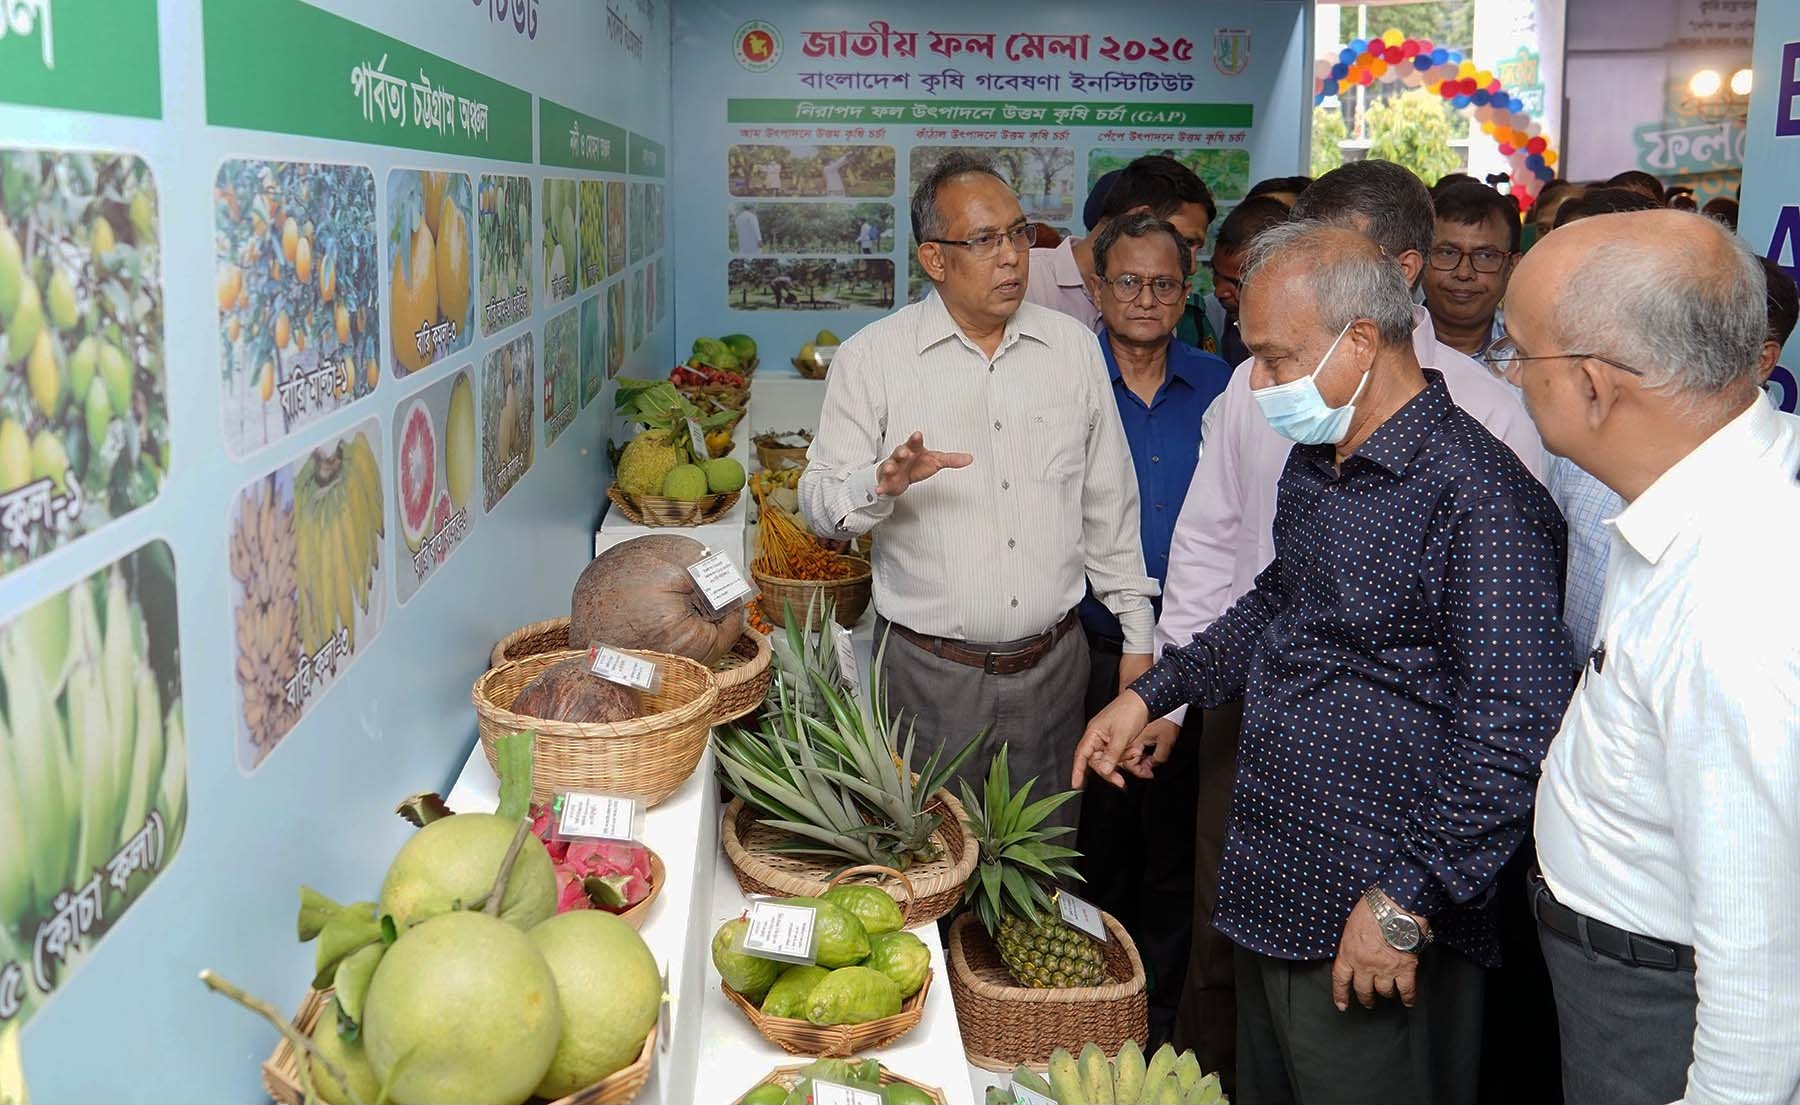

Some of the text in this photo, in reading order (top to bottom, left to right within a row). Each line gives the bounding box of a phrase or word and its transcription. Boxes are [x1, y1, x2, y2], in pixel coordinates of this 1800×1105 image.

[801, 21, 919, 59] জাতীয়
[928, 31, 996, 59] ফল
[1006, 33, 1091, 61] মেলা
[1100, 36, 1193, 61] ২০২৫
[351, 53, 489, 142] পার্বত্য চট্টগ্রাম অঞ্চল
[798, 69, 1195, 95] বাংলাদেশ কৃষি গবেষণা ইনস্টিটিউট
[795, 102, 1187, 124] নিরাপদ ফল উৎপাদনে উত্তম কৃষি চর্চা (GAP)
[765, 127, 812, 139] উৎপাদনে
[816, 127, 839, 138] উত্তম
[845, 127, 864, 142] কৃষি
[868, 127, 885, 139] চর্চা
[916, 127, 1070, 143] কাঁঠাল উৎপাদনে উত্তম কৃষি চর্চা
[1129, 130, 1174, 142] উৎপাদনে
[1178, 130, 1201, 142] উত্তম
[1205, 130, 1225, 145] কৃষি
[1229, 131, 1246, 143] চর্চা
[1642, 121, 1732, 169] ফল
[415, 320, 431, 357] বারি
[280, 366, 306, 418] বারি
[284, 656, 312, 710] বারি
[33, 871, 104, 993] (কাঁচা
[106, 810, 165, 893] কলা)
